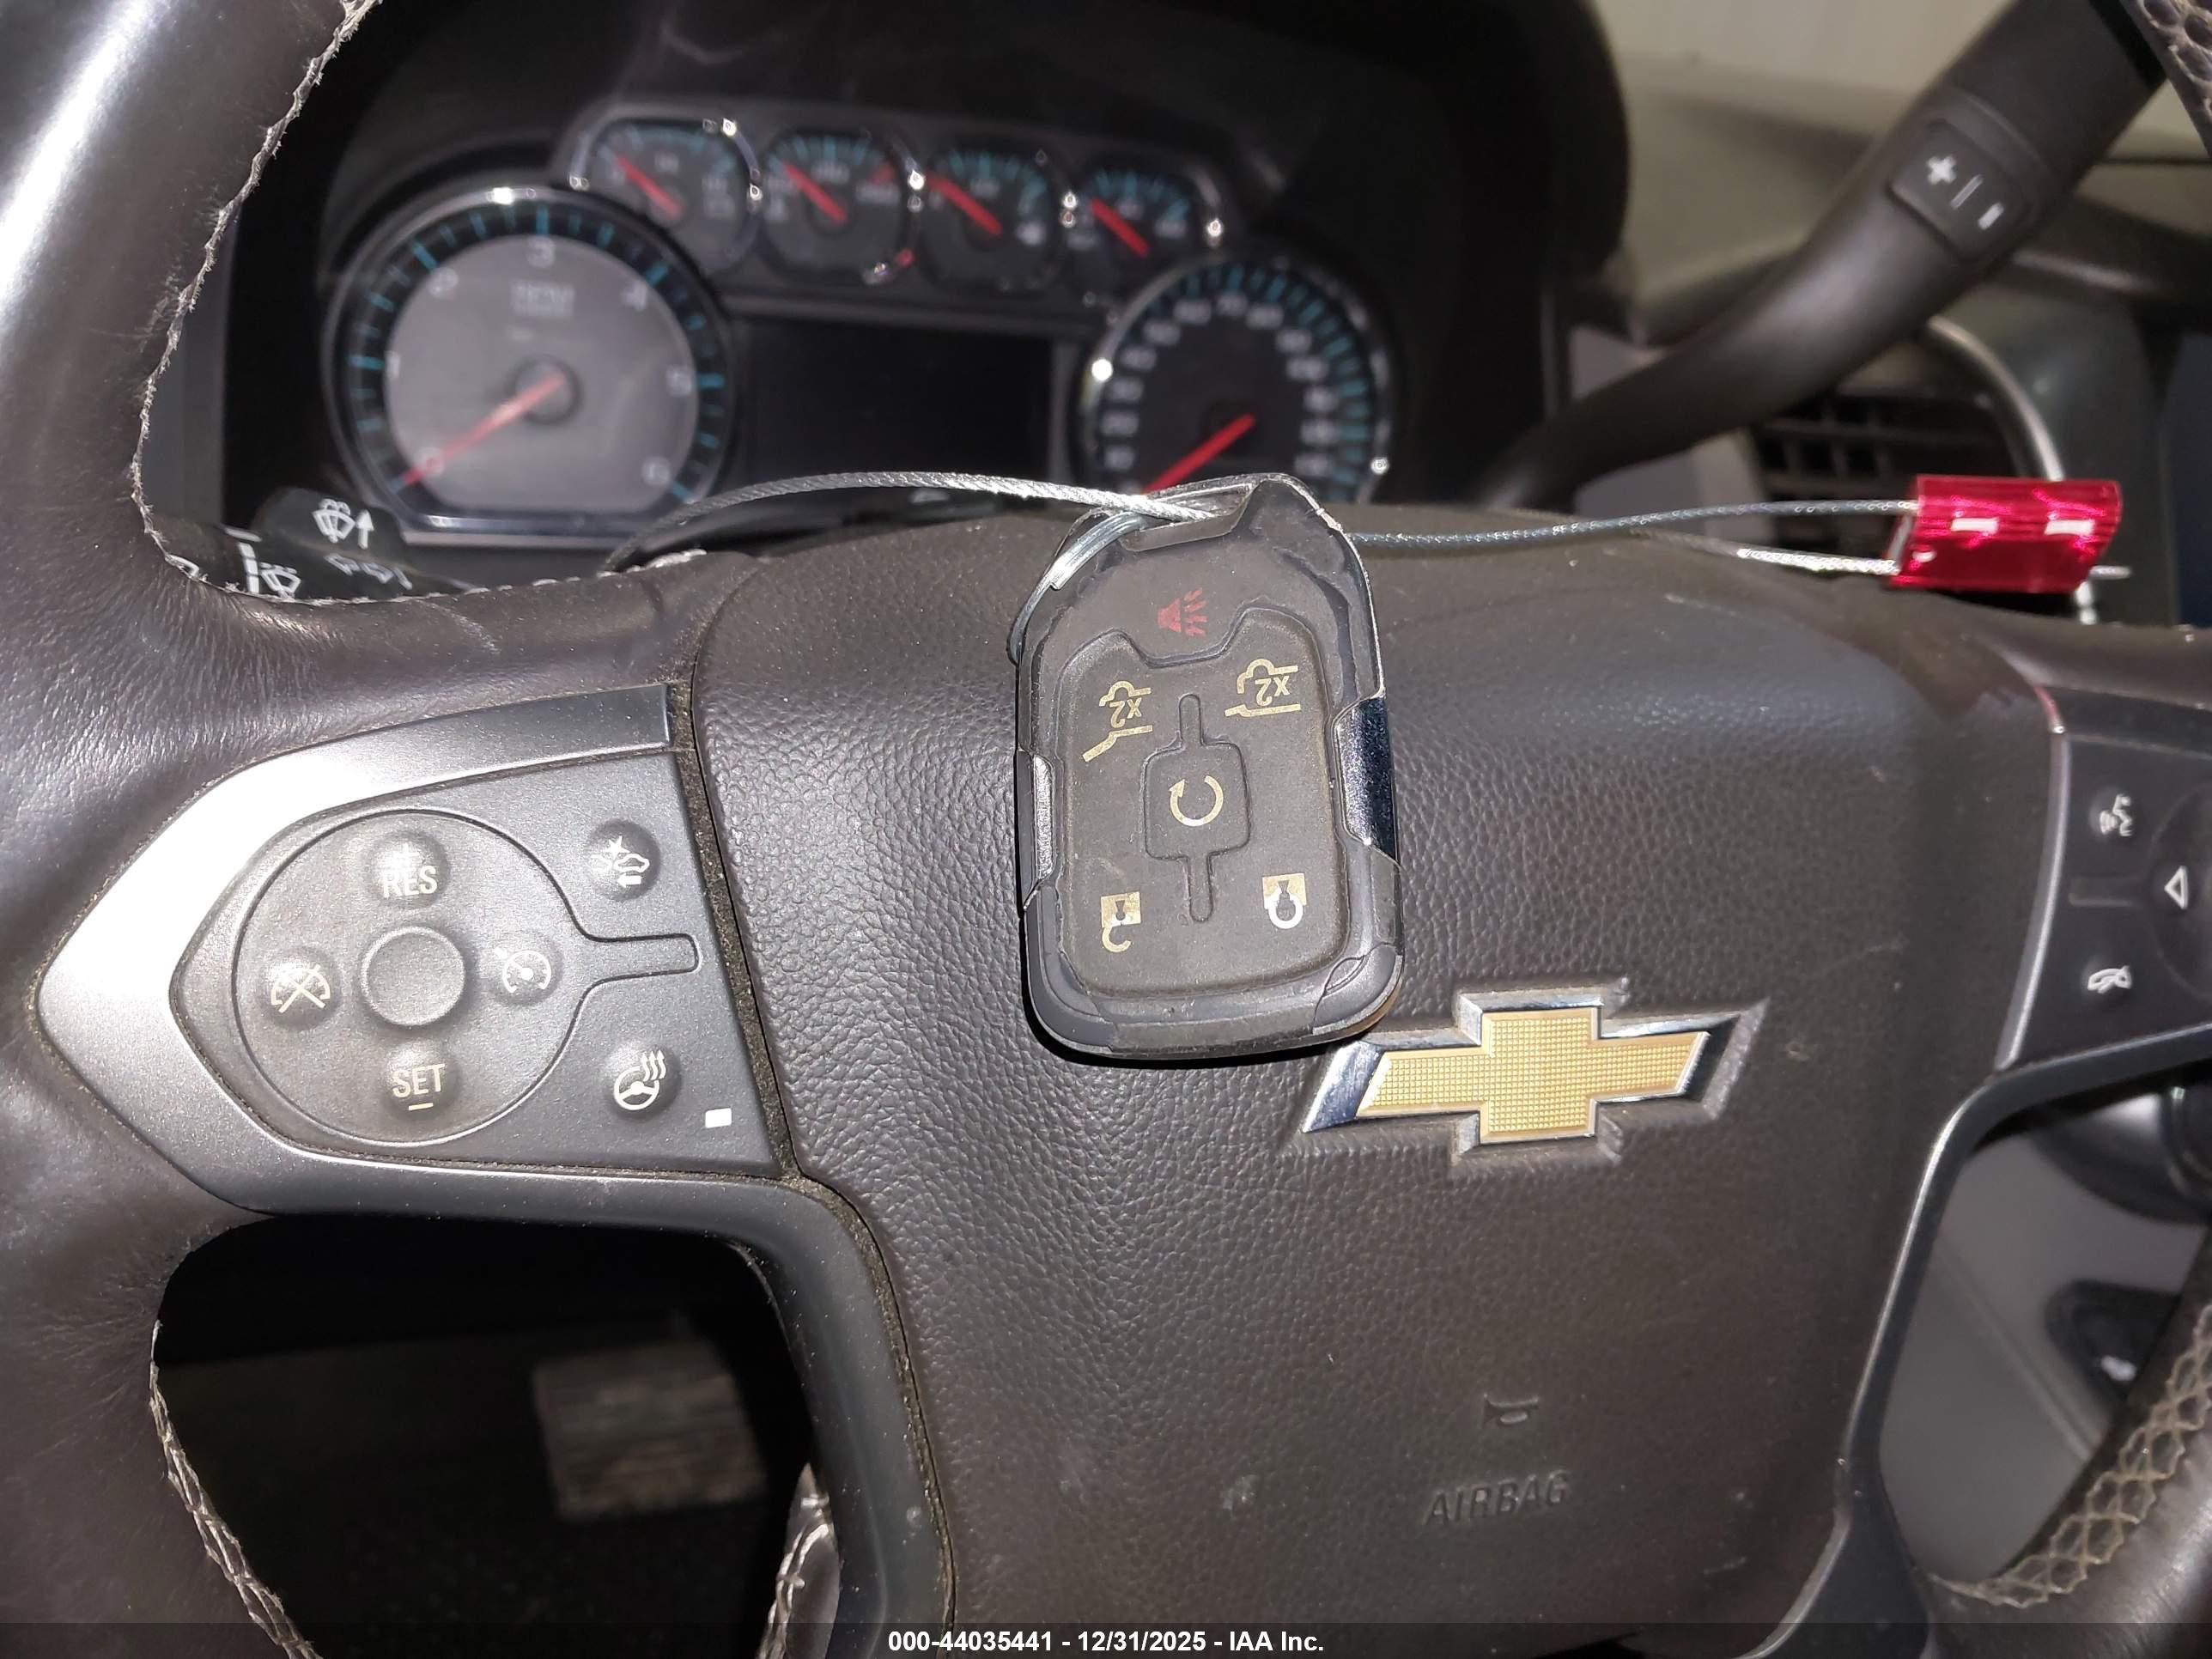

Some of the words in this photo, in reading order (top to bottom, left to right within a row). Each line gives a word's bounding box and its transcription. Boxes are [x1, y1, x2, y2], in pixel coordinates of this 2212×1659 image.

[382, 865, 437, 898] RES
[392, 1063, 446, 1098] SET
[1421, 1469, 1569, 1526] AIRBAG
